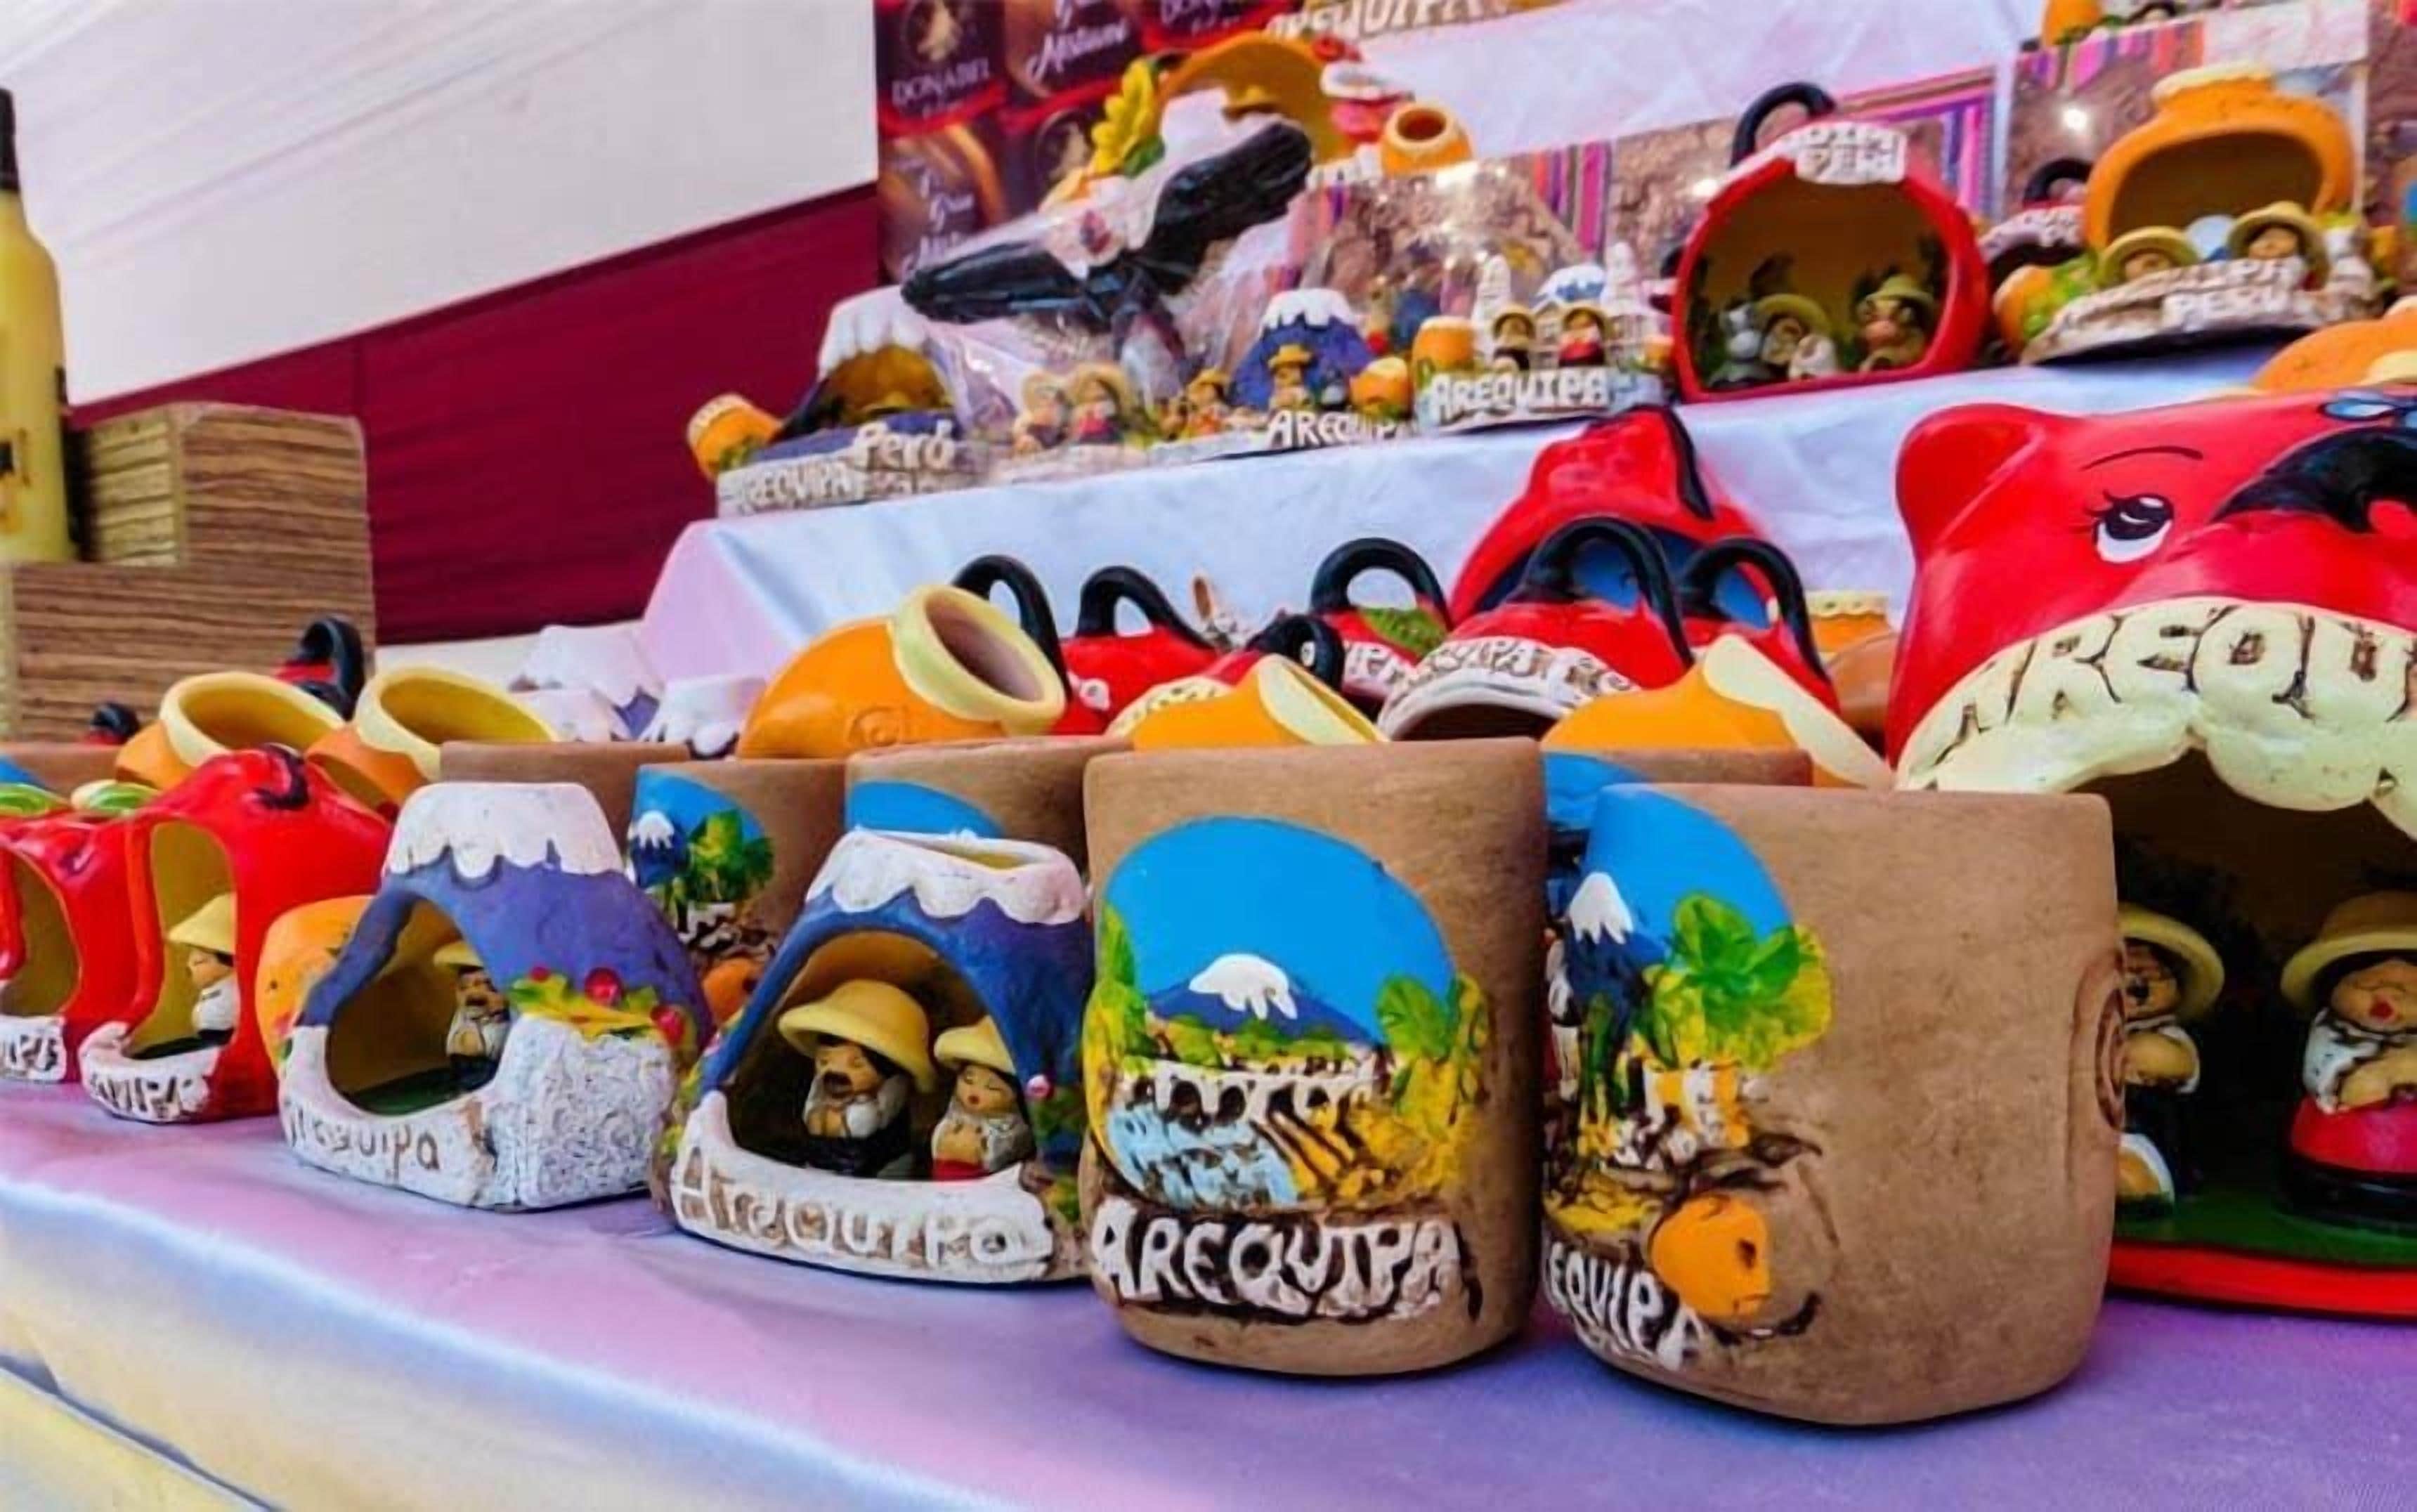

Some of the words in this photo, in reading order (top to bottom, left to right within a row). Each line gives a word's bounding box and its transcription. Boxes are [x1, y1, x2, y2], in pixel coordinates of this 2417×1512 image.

[1428, 367, 1609, 424] AREQUIPA
[1901, 604, 2417, 790] AREQU
[1090, 1196, 1461, 1321] AREQUIPA
